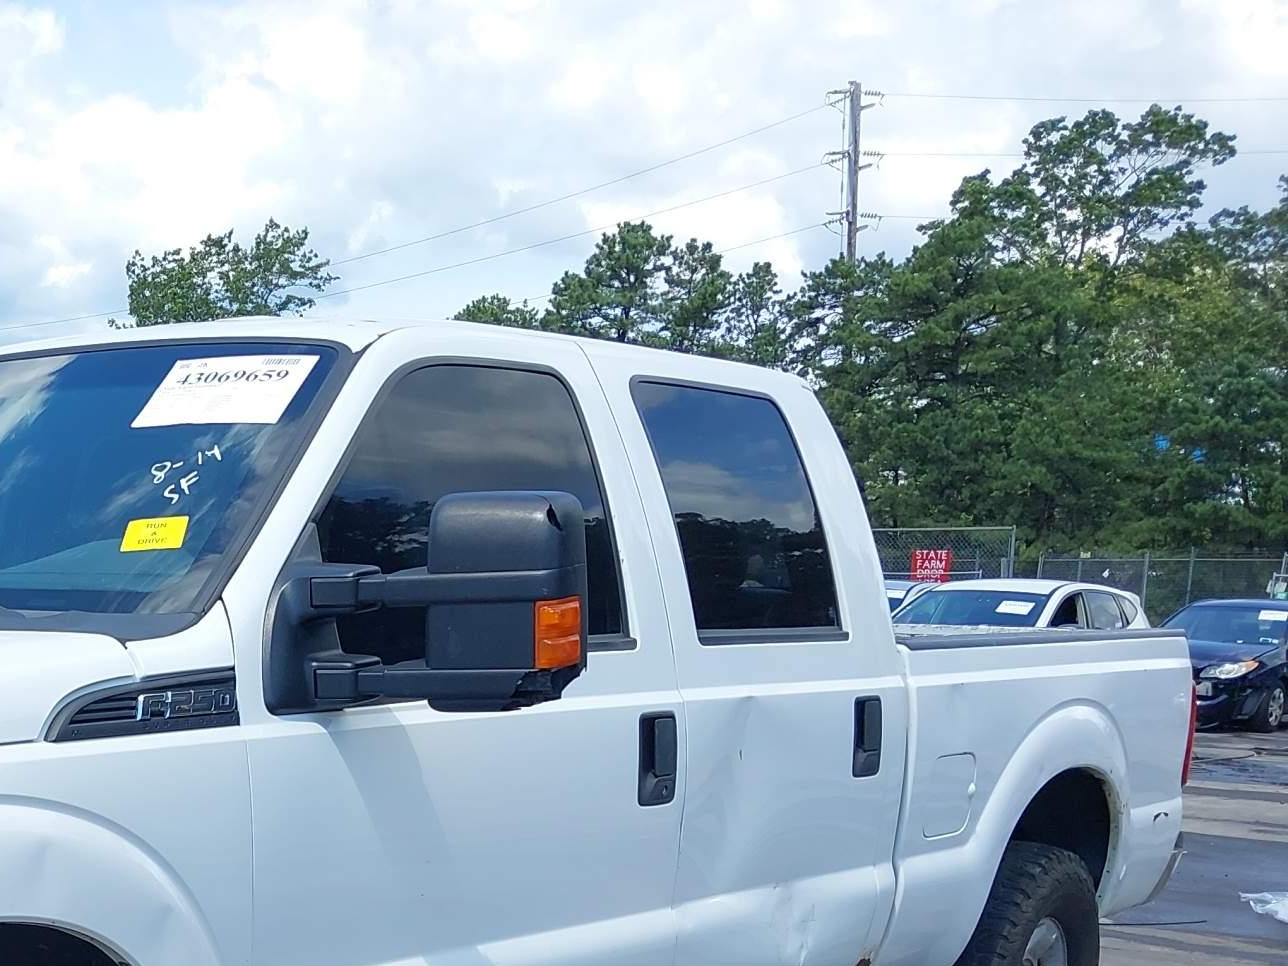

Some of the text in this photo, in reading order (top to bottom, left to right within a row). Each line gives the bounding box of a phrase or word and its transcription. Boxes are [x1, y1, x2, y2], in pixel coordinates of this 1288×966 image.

[176, 369, 291, 385] 43069659
[915, 549, 948, 560] STATE
[916, 559, 946, 569] FARM
[916, 568, 944, 578] DROP
